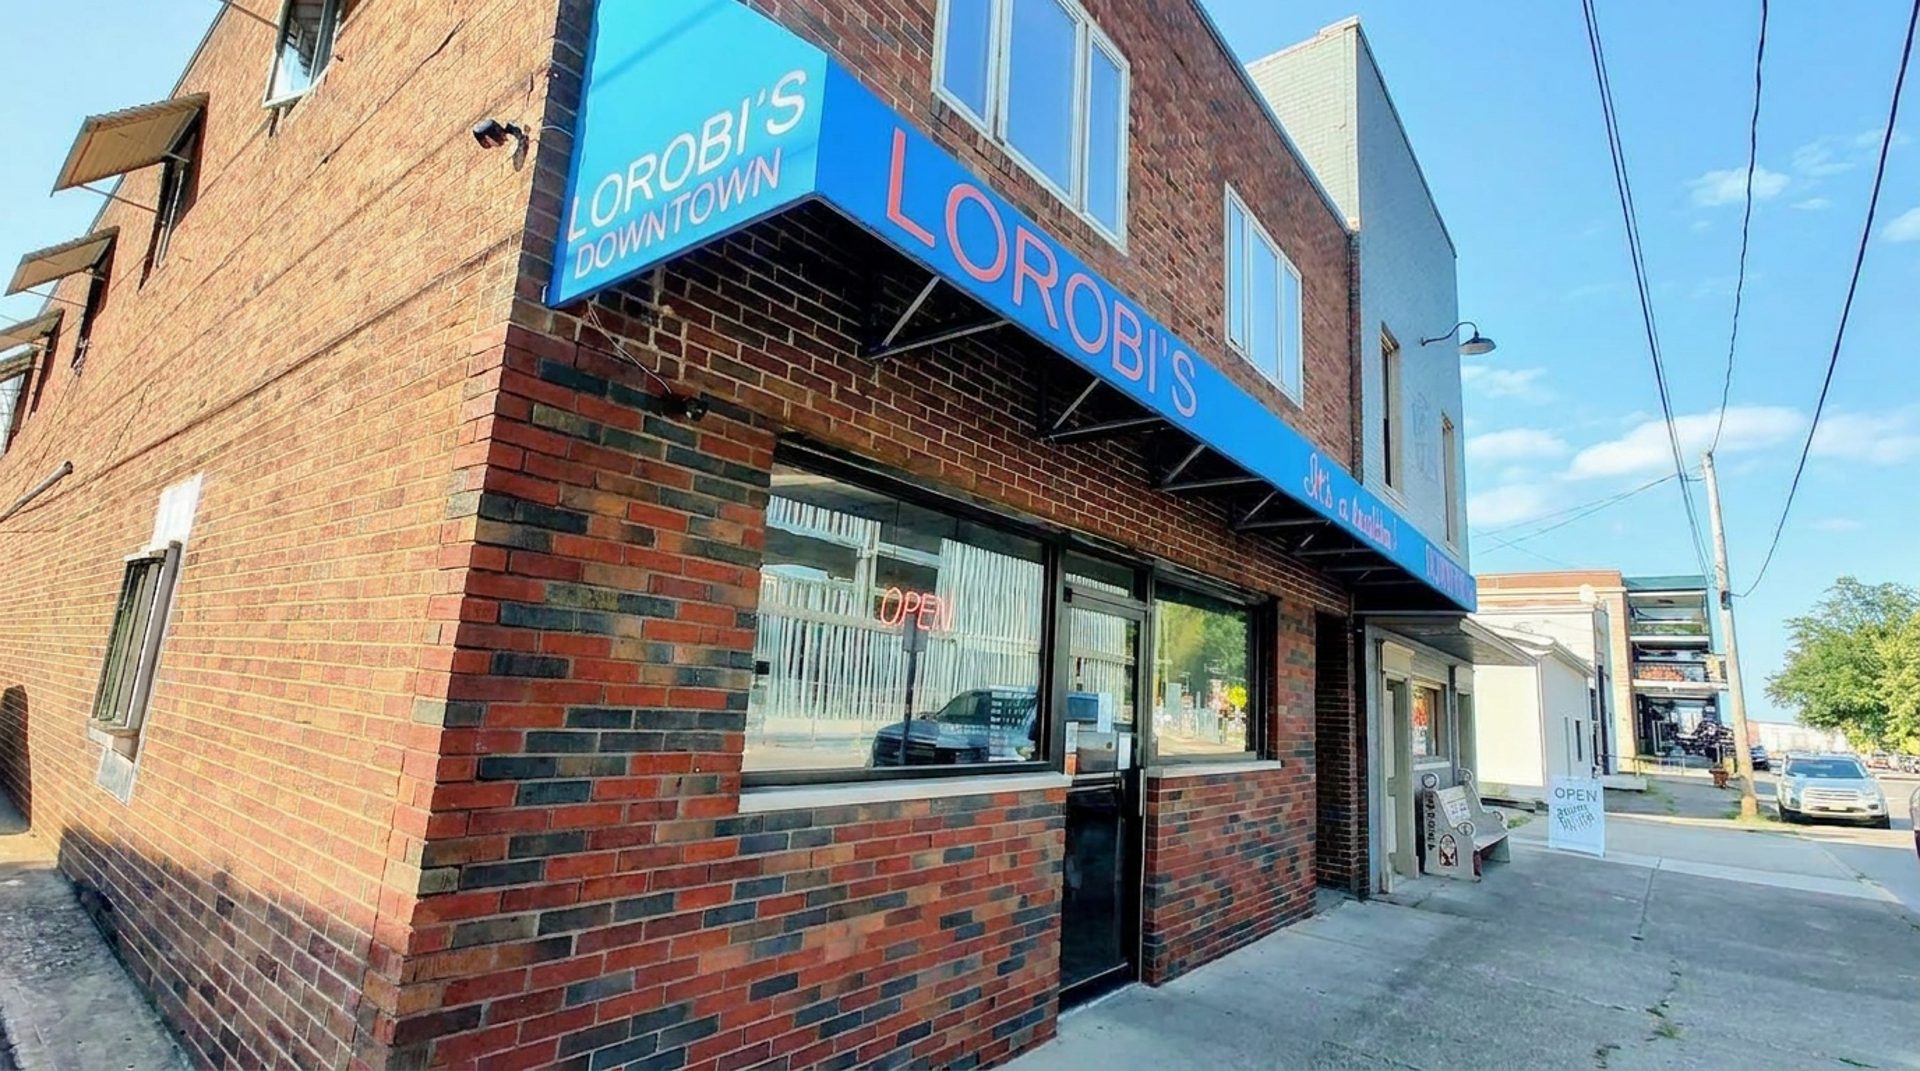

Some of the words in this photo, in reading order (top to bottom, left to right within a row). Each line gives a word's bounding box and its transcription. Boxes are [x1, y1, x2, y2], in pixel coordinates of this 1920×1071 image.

[567, 70, 808, 243] LOROBI'S
[573, 148, 782, 279] DOWNTOWN
[886, 127, 1198, 419] LOROBI'S
[1338, 498, 1349, 522] a
[880, 586, 956, 632] OPEN
[1554, 786, 1598, 802] OPEN
